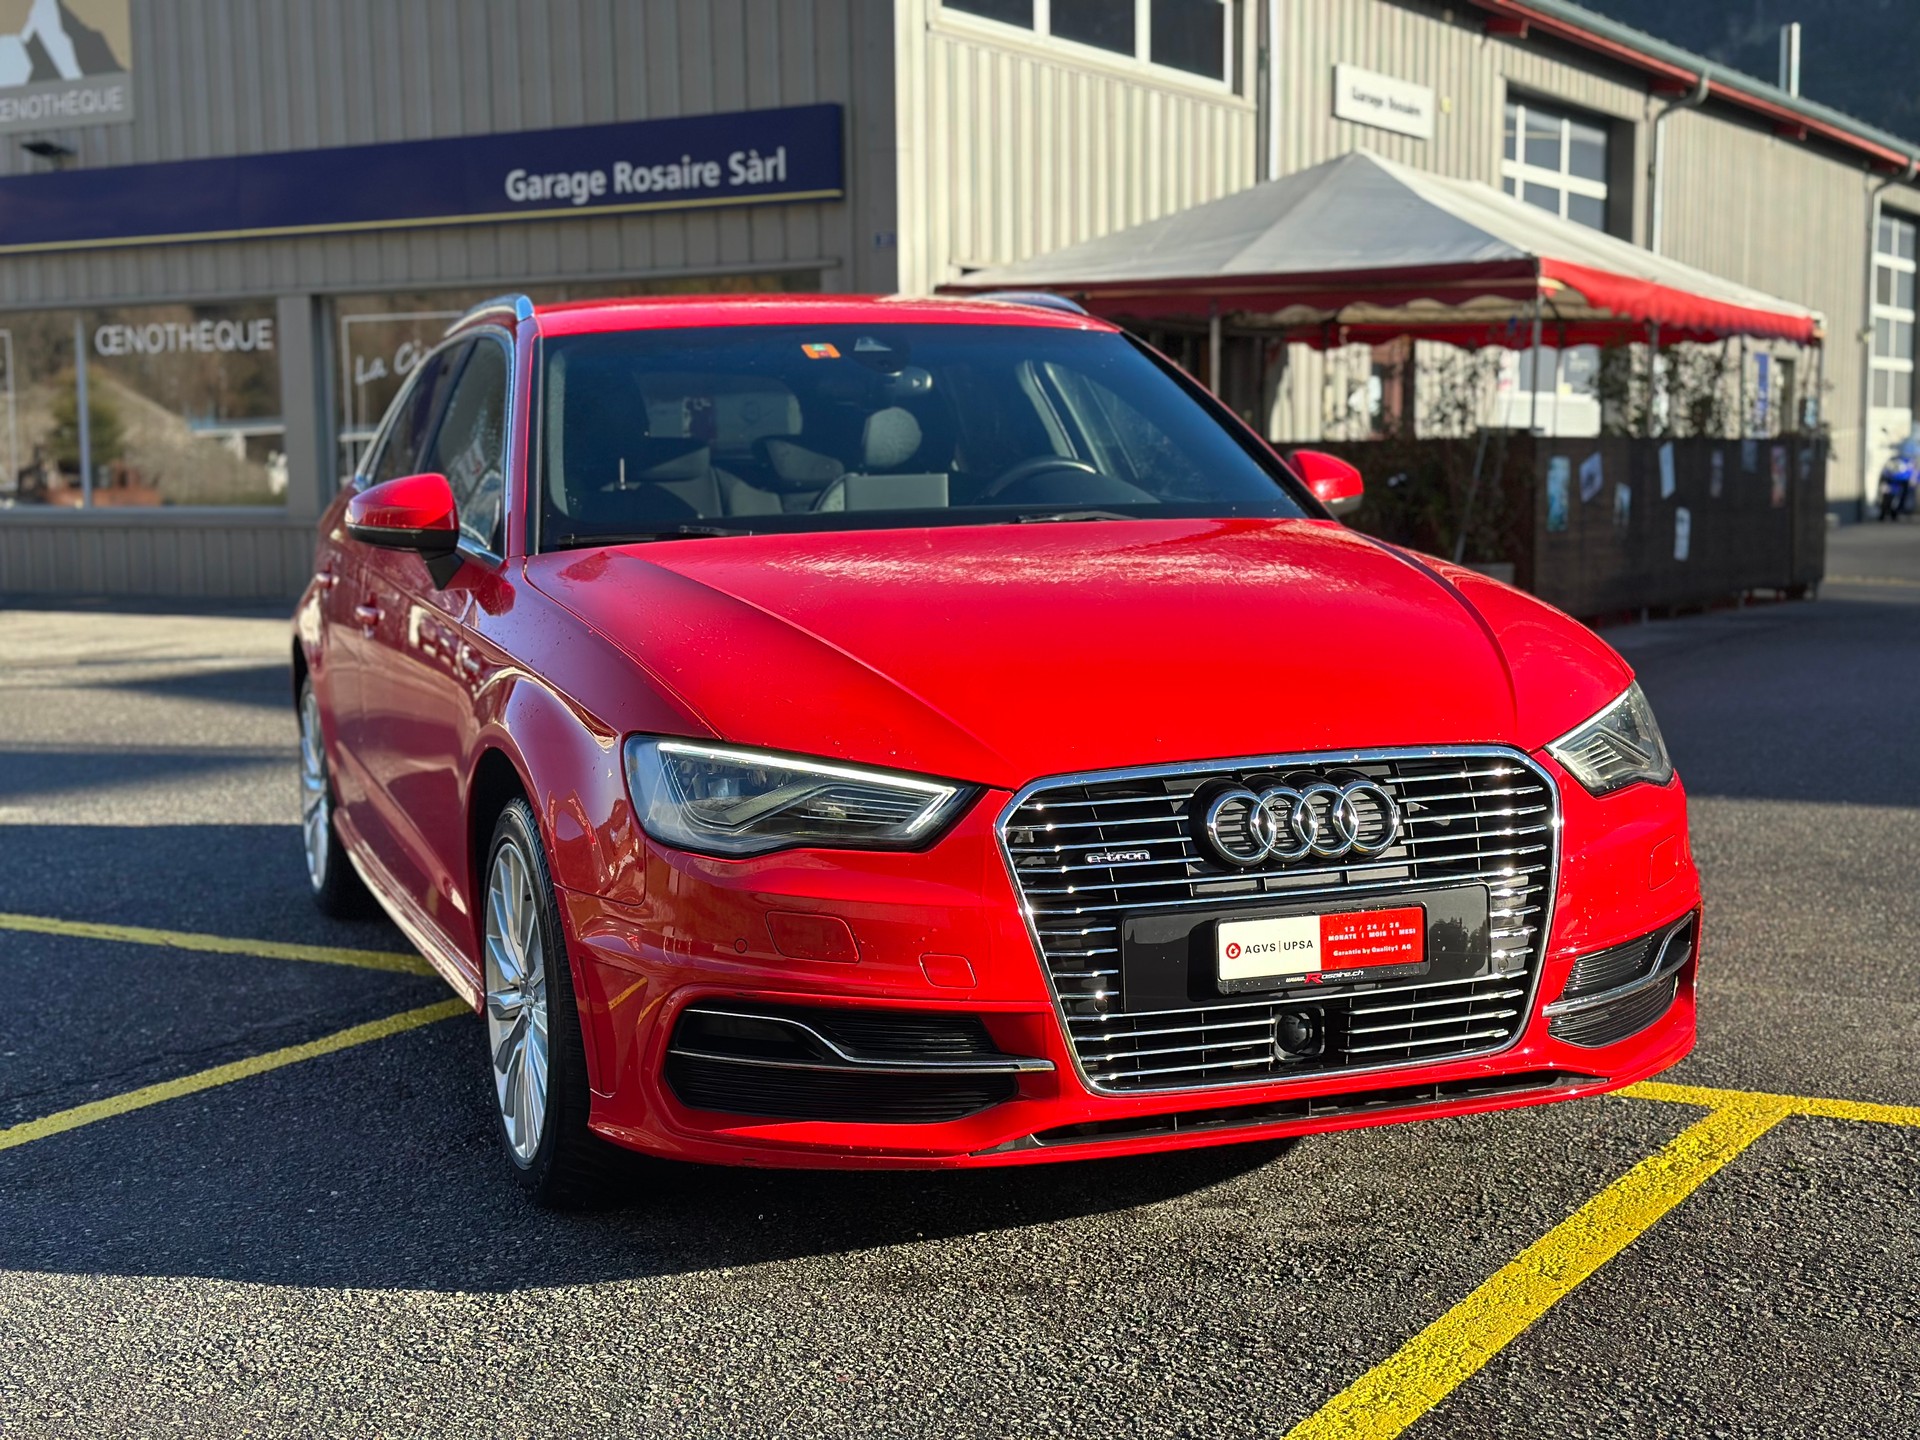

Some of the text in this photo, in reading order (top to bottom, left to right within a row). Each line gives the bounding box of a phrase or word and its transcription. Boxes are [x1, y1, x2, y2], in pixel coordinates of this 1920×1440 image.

[505, 146, 786, 205] Garage Rosaire Sàrl
[355, 354, 388, 385] La
[1328, 933, 1357, 941] MONATE
[1245, 940, 1313, 954] AGVS UPSA
[1333, 948, 1361, 956] Garantie
